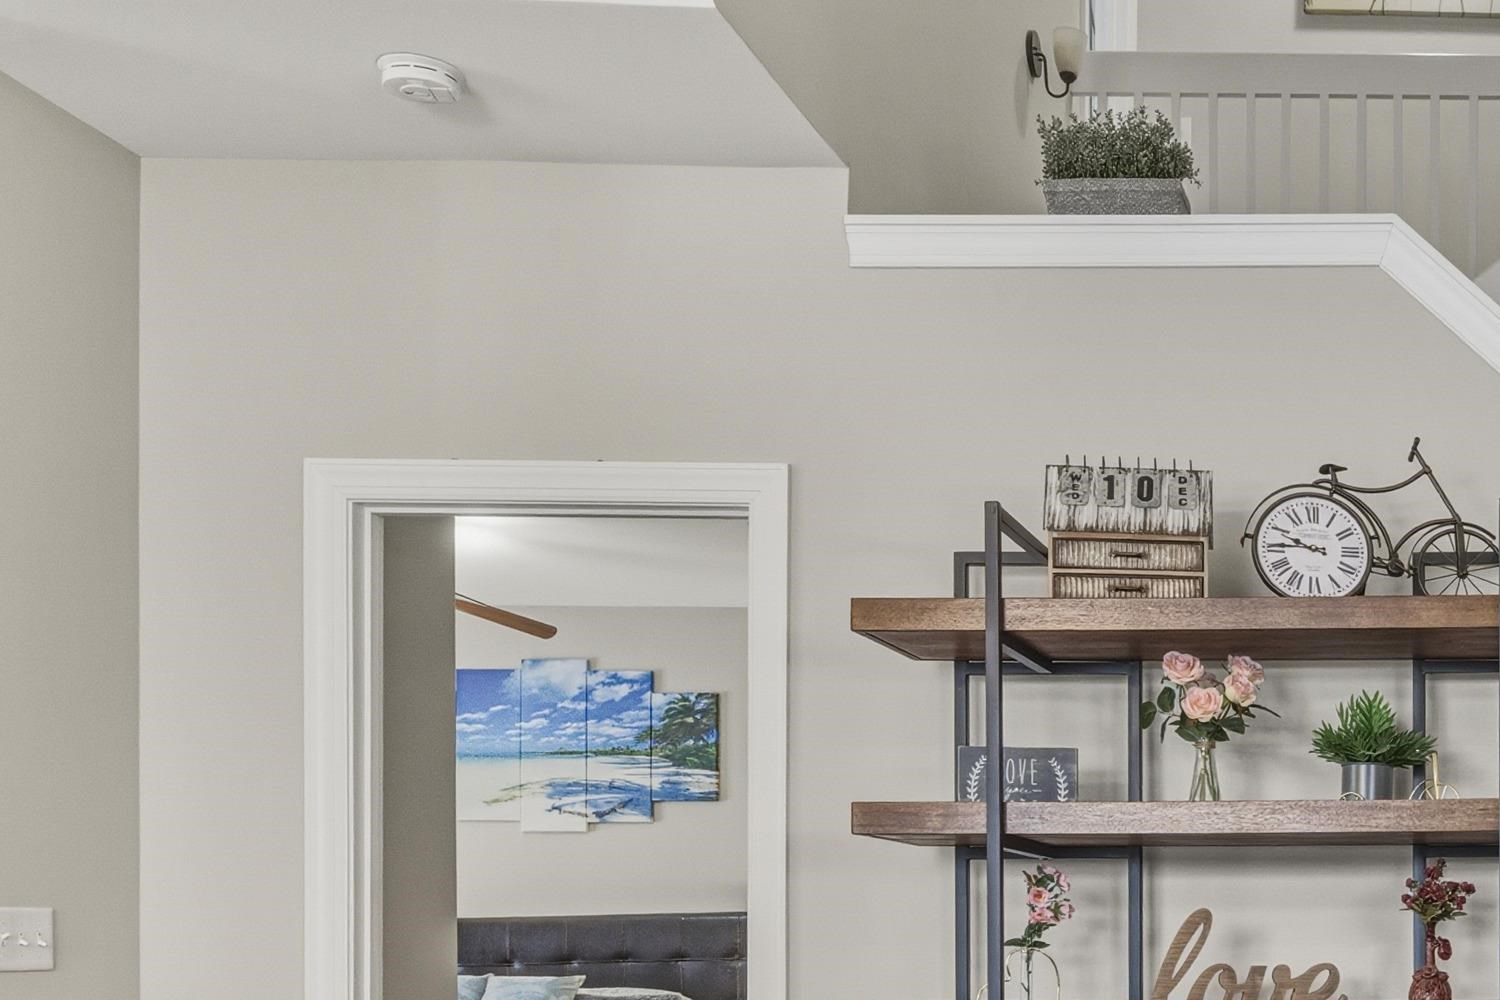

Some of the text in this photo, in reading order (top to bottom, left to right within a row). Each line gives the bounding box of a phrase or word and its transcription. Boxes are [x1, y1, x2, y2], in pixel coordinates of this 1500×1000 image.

[1069, 472, 1083, 500] WED
[1177, 476, 1189, 507] DEC
[1006, 758, 1038, 785] OVE
